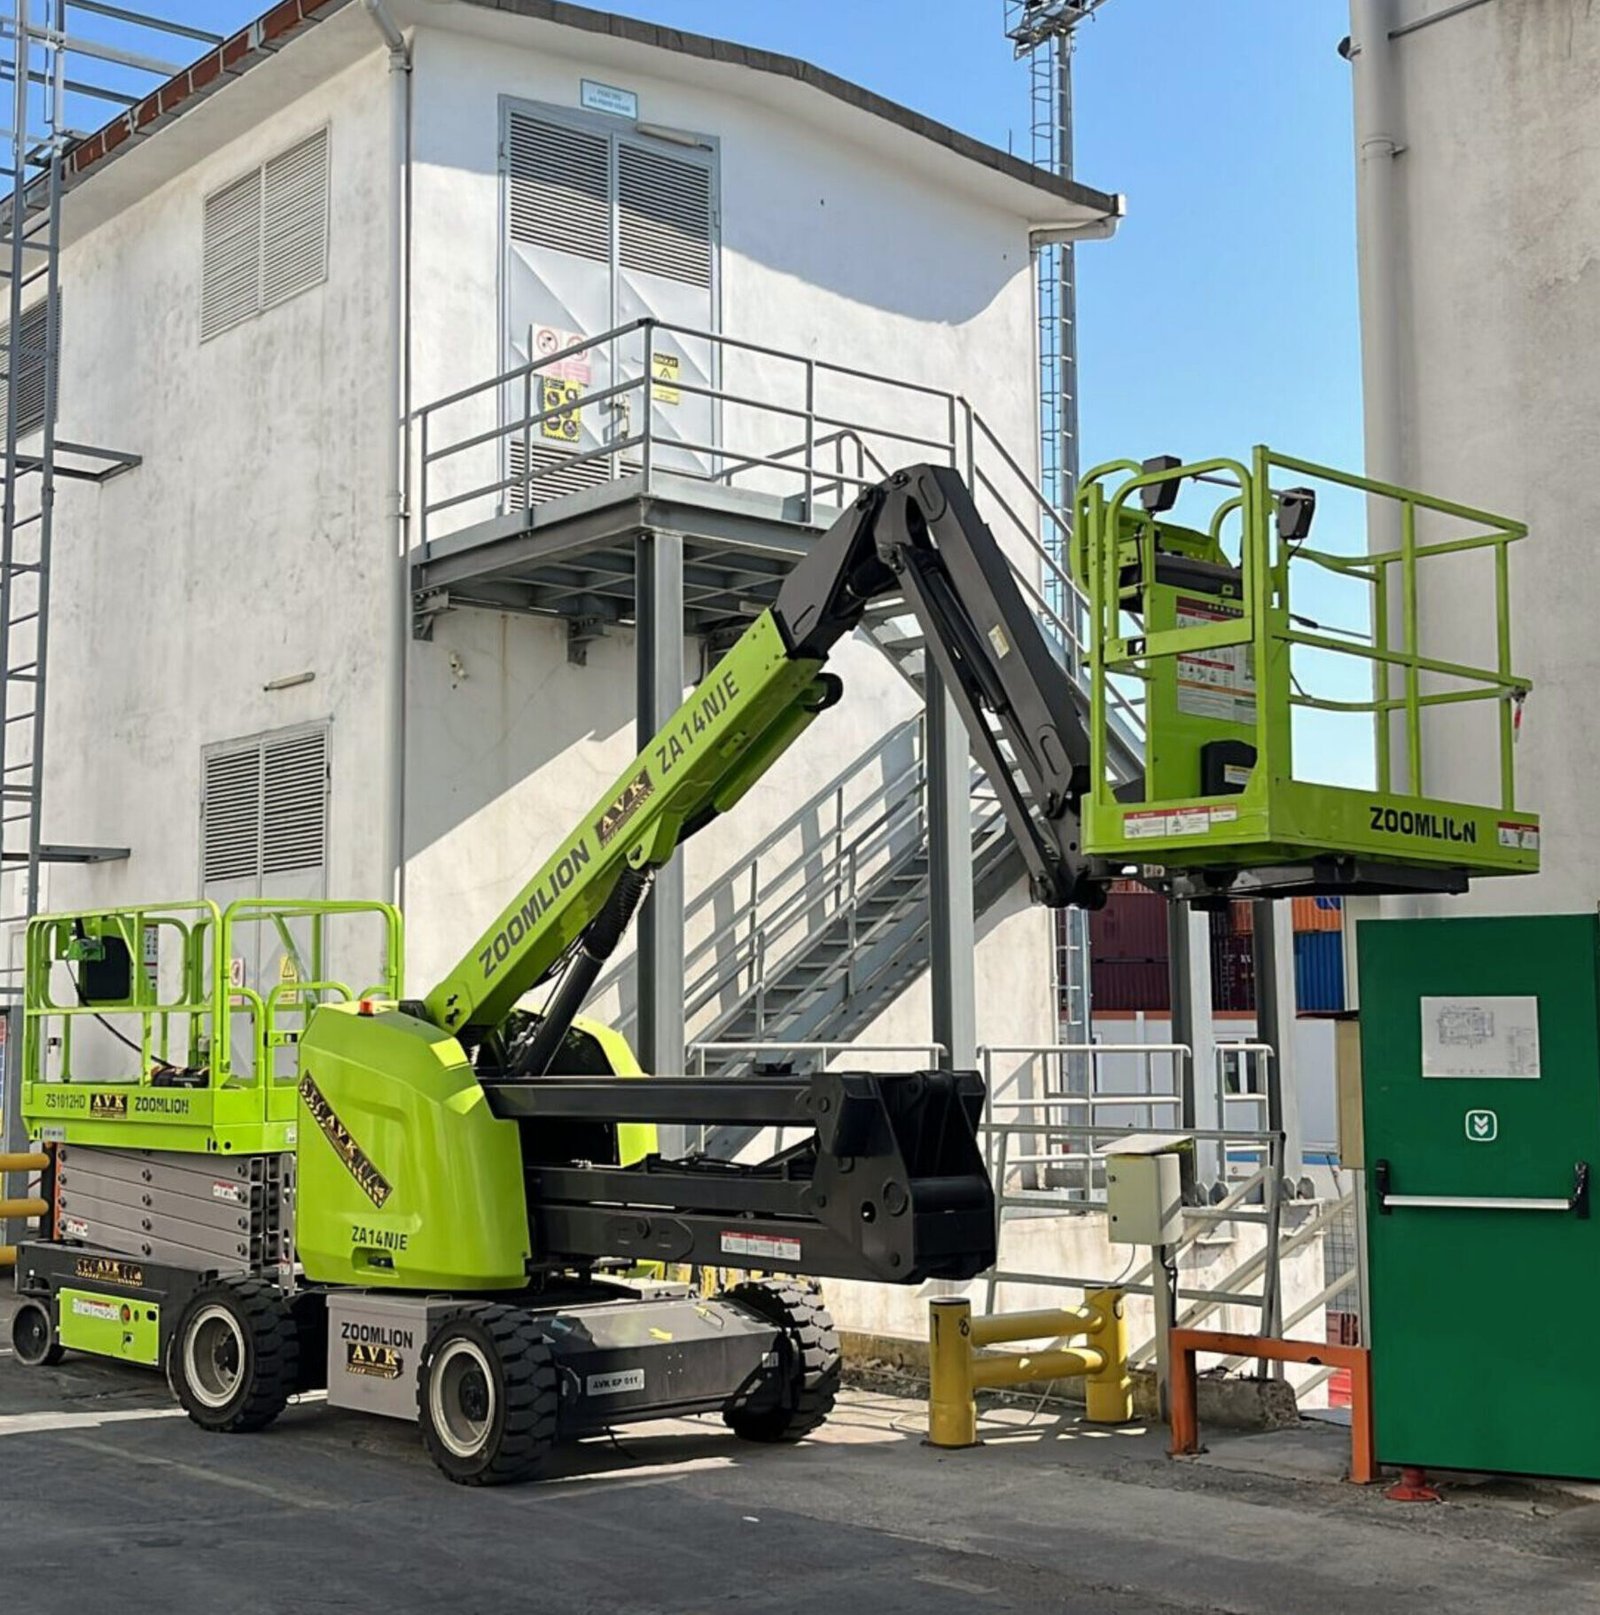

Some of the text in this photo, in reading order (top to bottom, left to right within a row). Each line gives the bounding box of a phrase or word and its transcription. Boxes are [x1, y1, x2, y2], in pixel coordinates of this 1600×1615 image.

[478, 671, 741, 979] ZOOMLION AVK ZA14NJE
[1370, 807, 1476, 844] ZOOMLION
[93, 1094, 125, 1108] AVK
[135, 1097, 189, 1115] ZOOMLION
[352, 1226, 408, 1251] ZA14NJE
[341, 1321, 414, 1350] ZOOMLION
[352, 1344, 398, 1366] AVK
